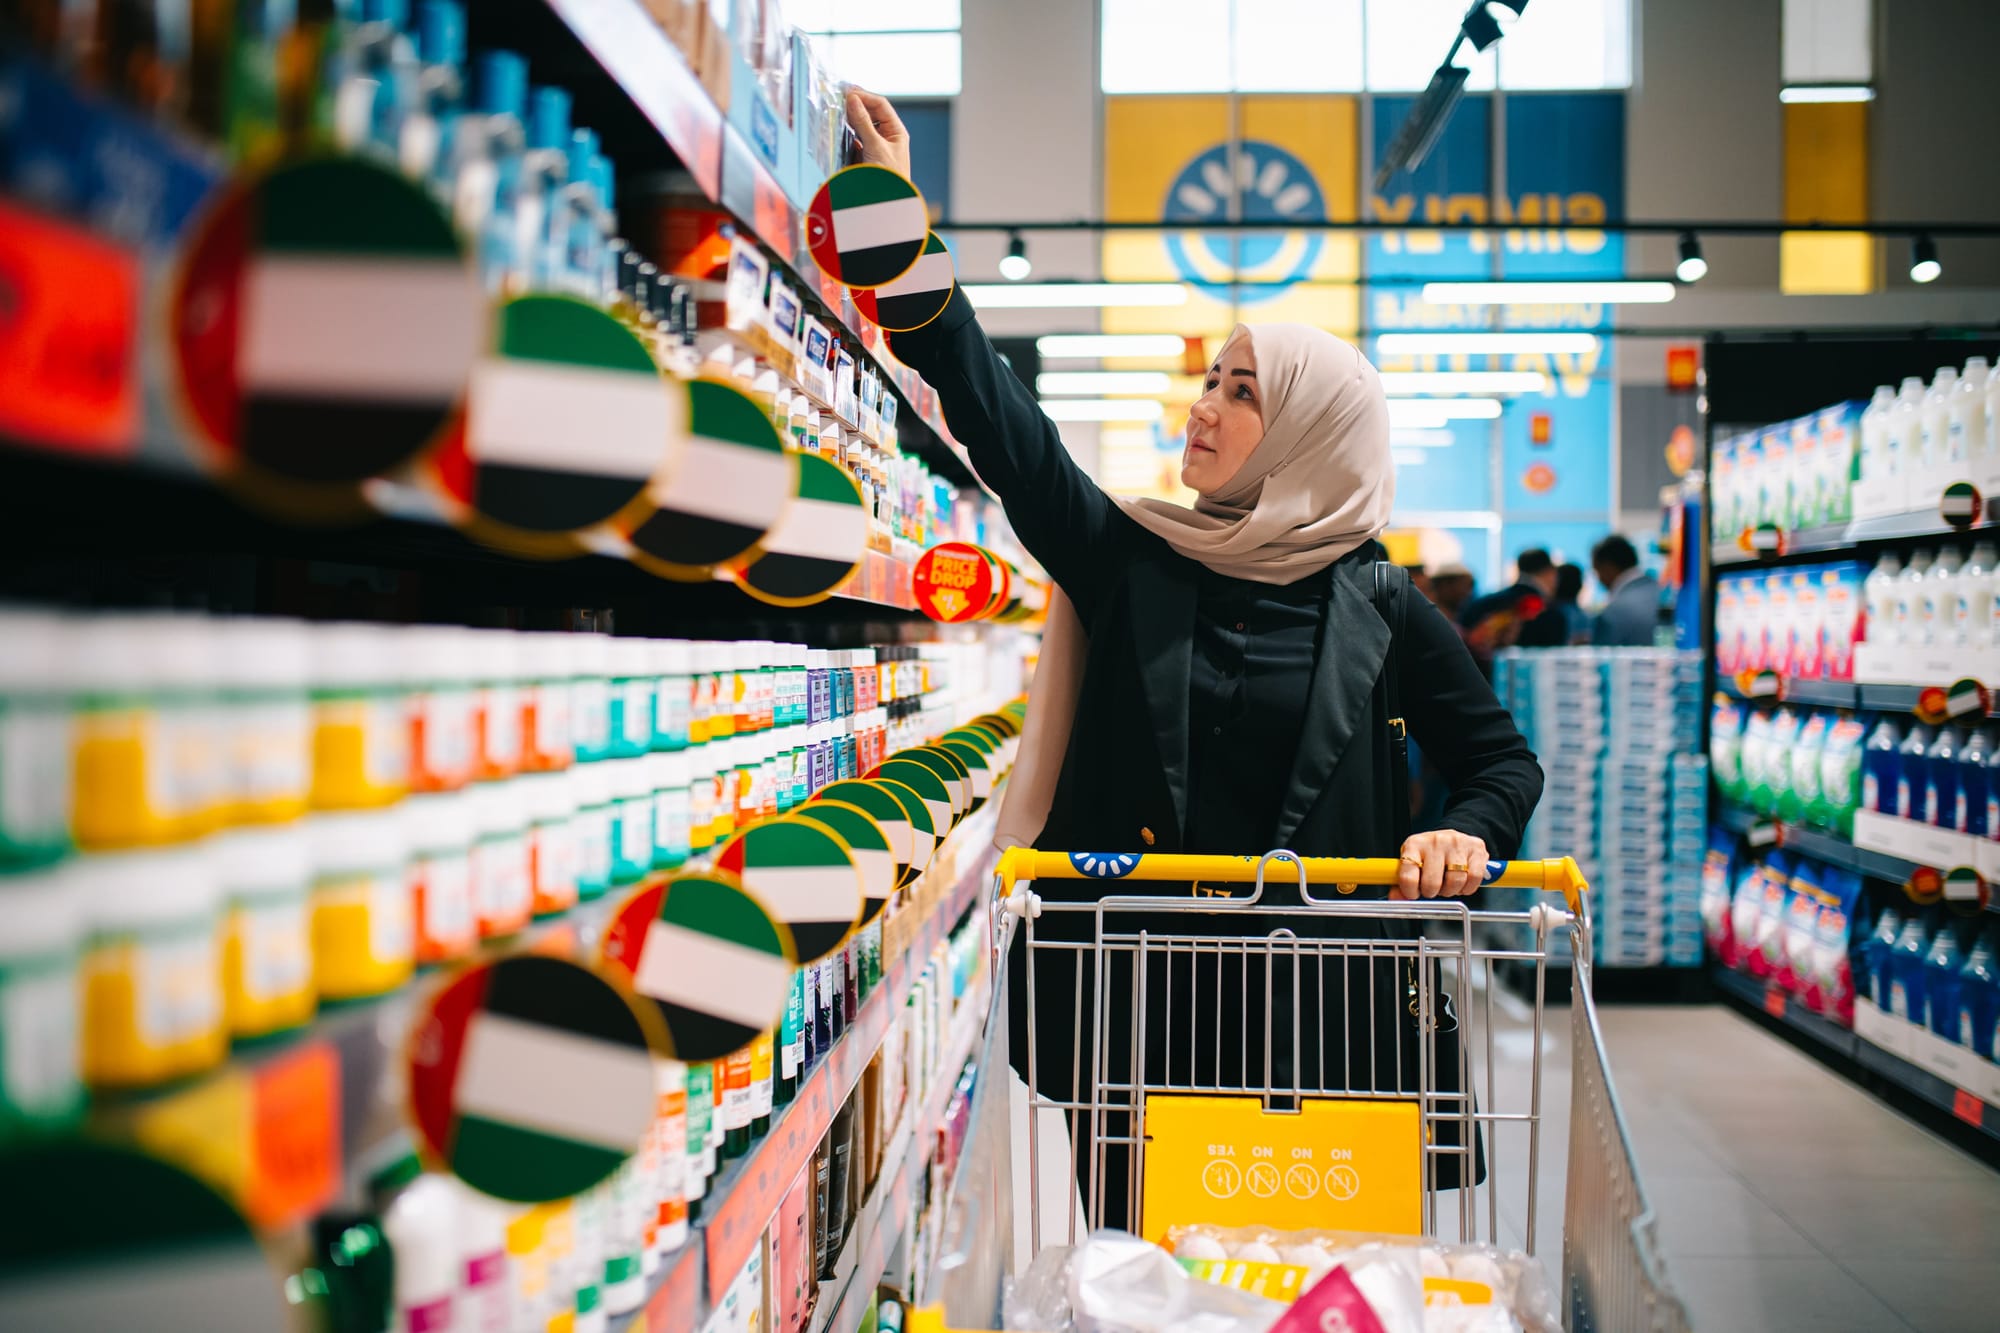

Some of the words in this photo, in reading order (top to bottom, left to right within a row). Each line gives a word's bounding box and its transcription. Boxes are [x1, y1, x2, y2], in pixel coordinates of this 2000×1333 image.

[932, 555, 980, 578] PRICE
[930, 571, 977, 589] DROP
[1208, 1144, 1235, 1156] YES
[1252, 1146, 1273, 1158] NO
[1291, 1147, 1312, 1159] NO
[1331, 1149, 1352, 1160] NO
